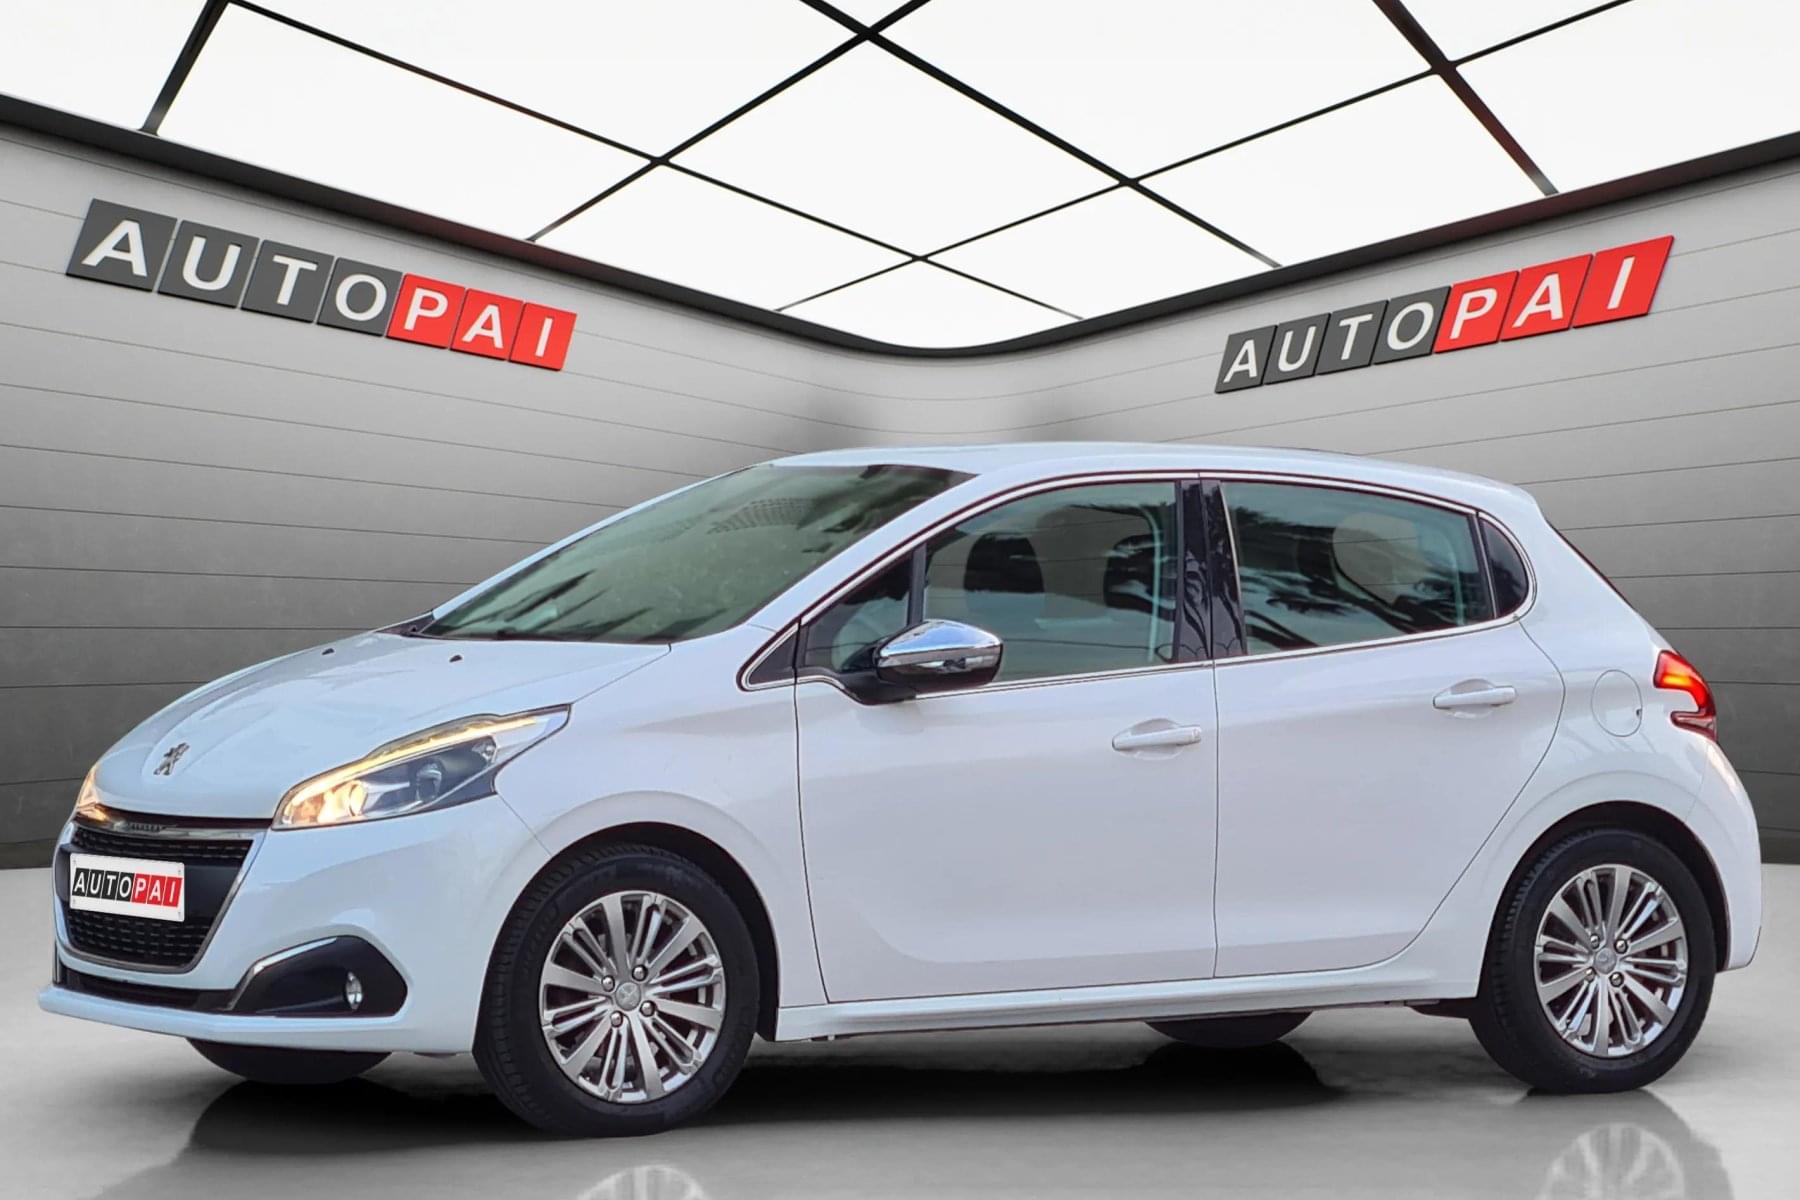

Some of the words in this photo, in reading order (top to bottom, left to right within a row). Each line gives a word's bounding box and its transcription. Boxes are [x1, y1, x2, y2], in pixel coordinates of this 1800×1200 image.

[81, 219, 553, 357] AUTOPAI
[1223, 256, 1635, 383] AUTOPAI
[74, 871, 176, 903] AUTOPAI
